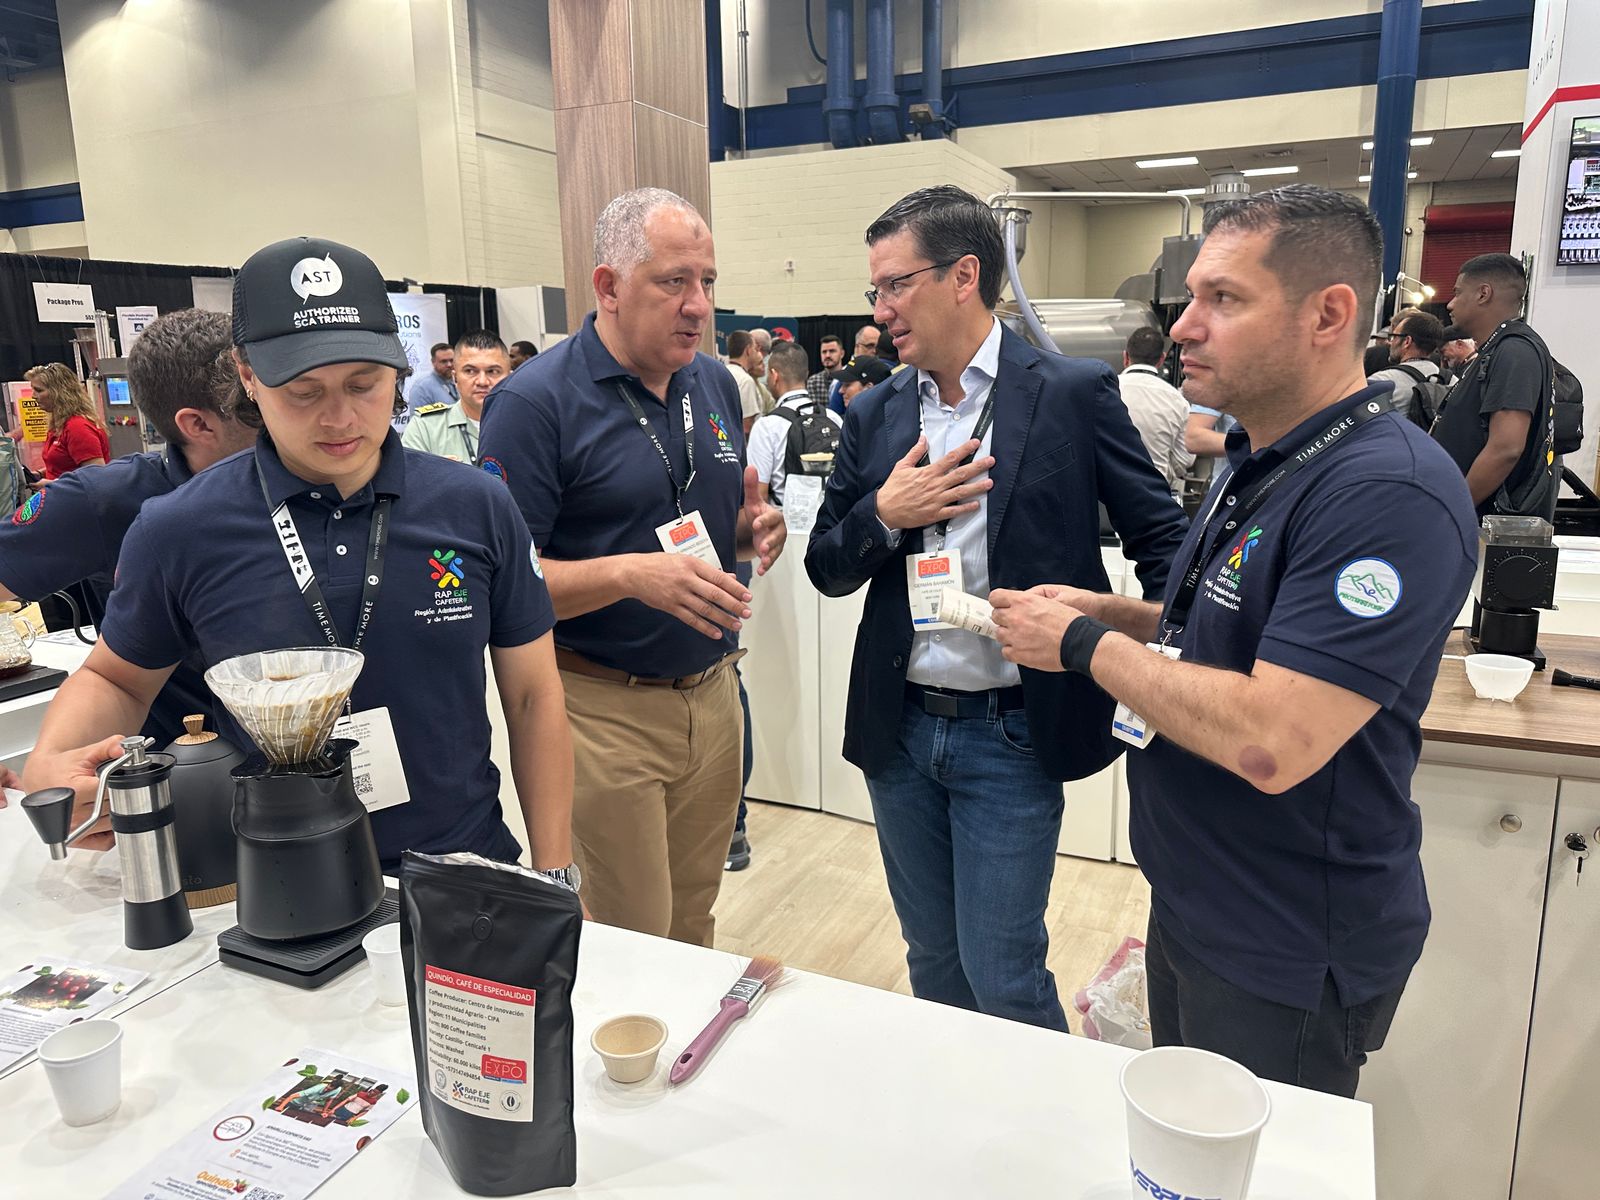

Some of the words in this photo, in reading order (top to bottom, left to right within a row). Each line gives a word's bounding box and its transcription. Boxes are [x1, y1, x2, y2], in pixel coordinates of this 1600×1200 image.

[301, 271, 331, 285] AST
[47, 298, 71, 306] Package
[293, 306, 359, 321] AUTHORIZED
[294, 319, 317, 329] SCA
[317, 315, 361, 325] TRAINER
[650, 434, 665, 456] MORE
[1295, 440, 1324, 463] TIME
[1324, 416, 1355, 444] MORE
[662, 454, 673, 472] TIME
[920, 561, 948, 575] EXPO
[434, 590, 453, 599] RAP
[453, 588, 468, 597] EJE
[312, 600, 329, 626] TIME
[361, 600, 374, 630] MORE
[456, 978, 472, 989] CAFÉ
[473, 982, 482, 991] DE
[483, 984, 532, 1002] ESPECIALIDAD
[429, 988, 443, 998] Coffee
[468, 999, 486, 1009] Centro
[494, 1006, 525, 1018] innovación
[432, 1000, 465, 1014] productividad
[450, 1025, 465, 1035] Coffee
[452, 1015, 487, 1030] Municipalities
[445, 1045, 465, 1056] Washed
[485, 1060, 523, 1079] EXPO
[464, 1086, 478, 1095] RAP
[478, 1090, 490, 1099] EJE
